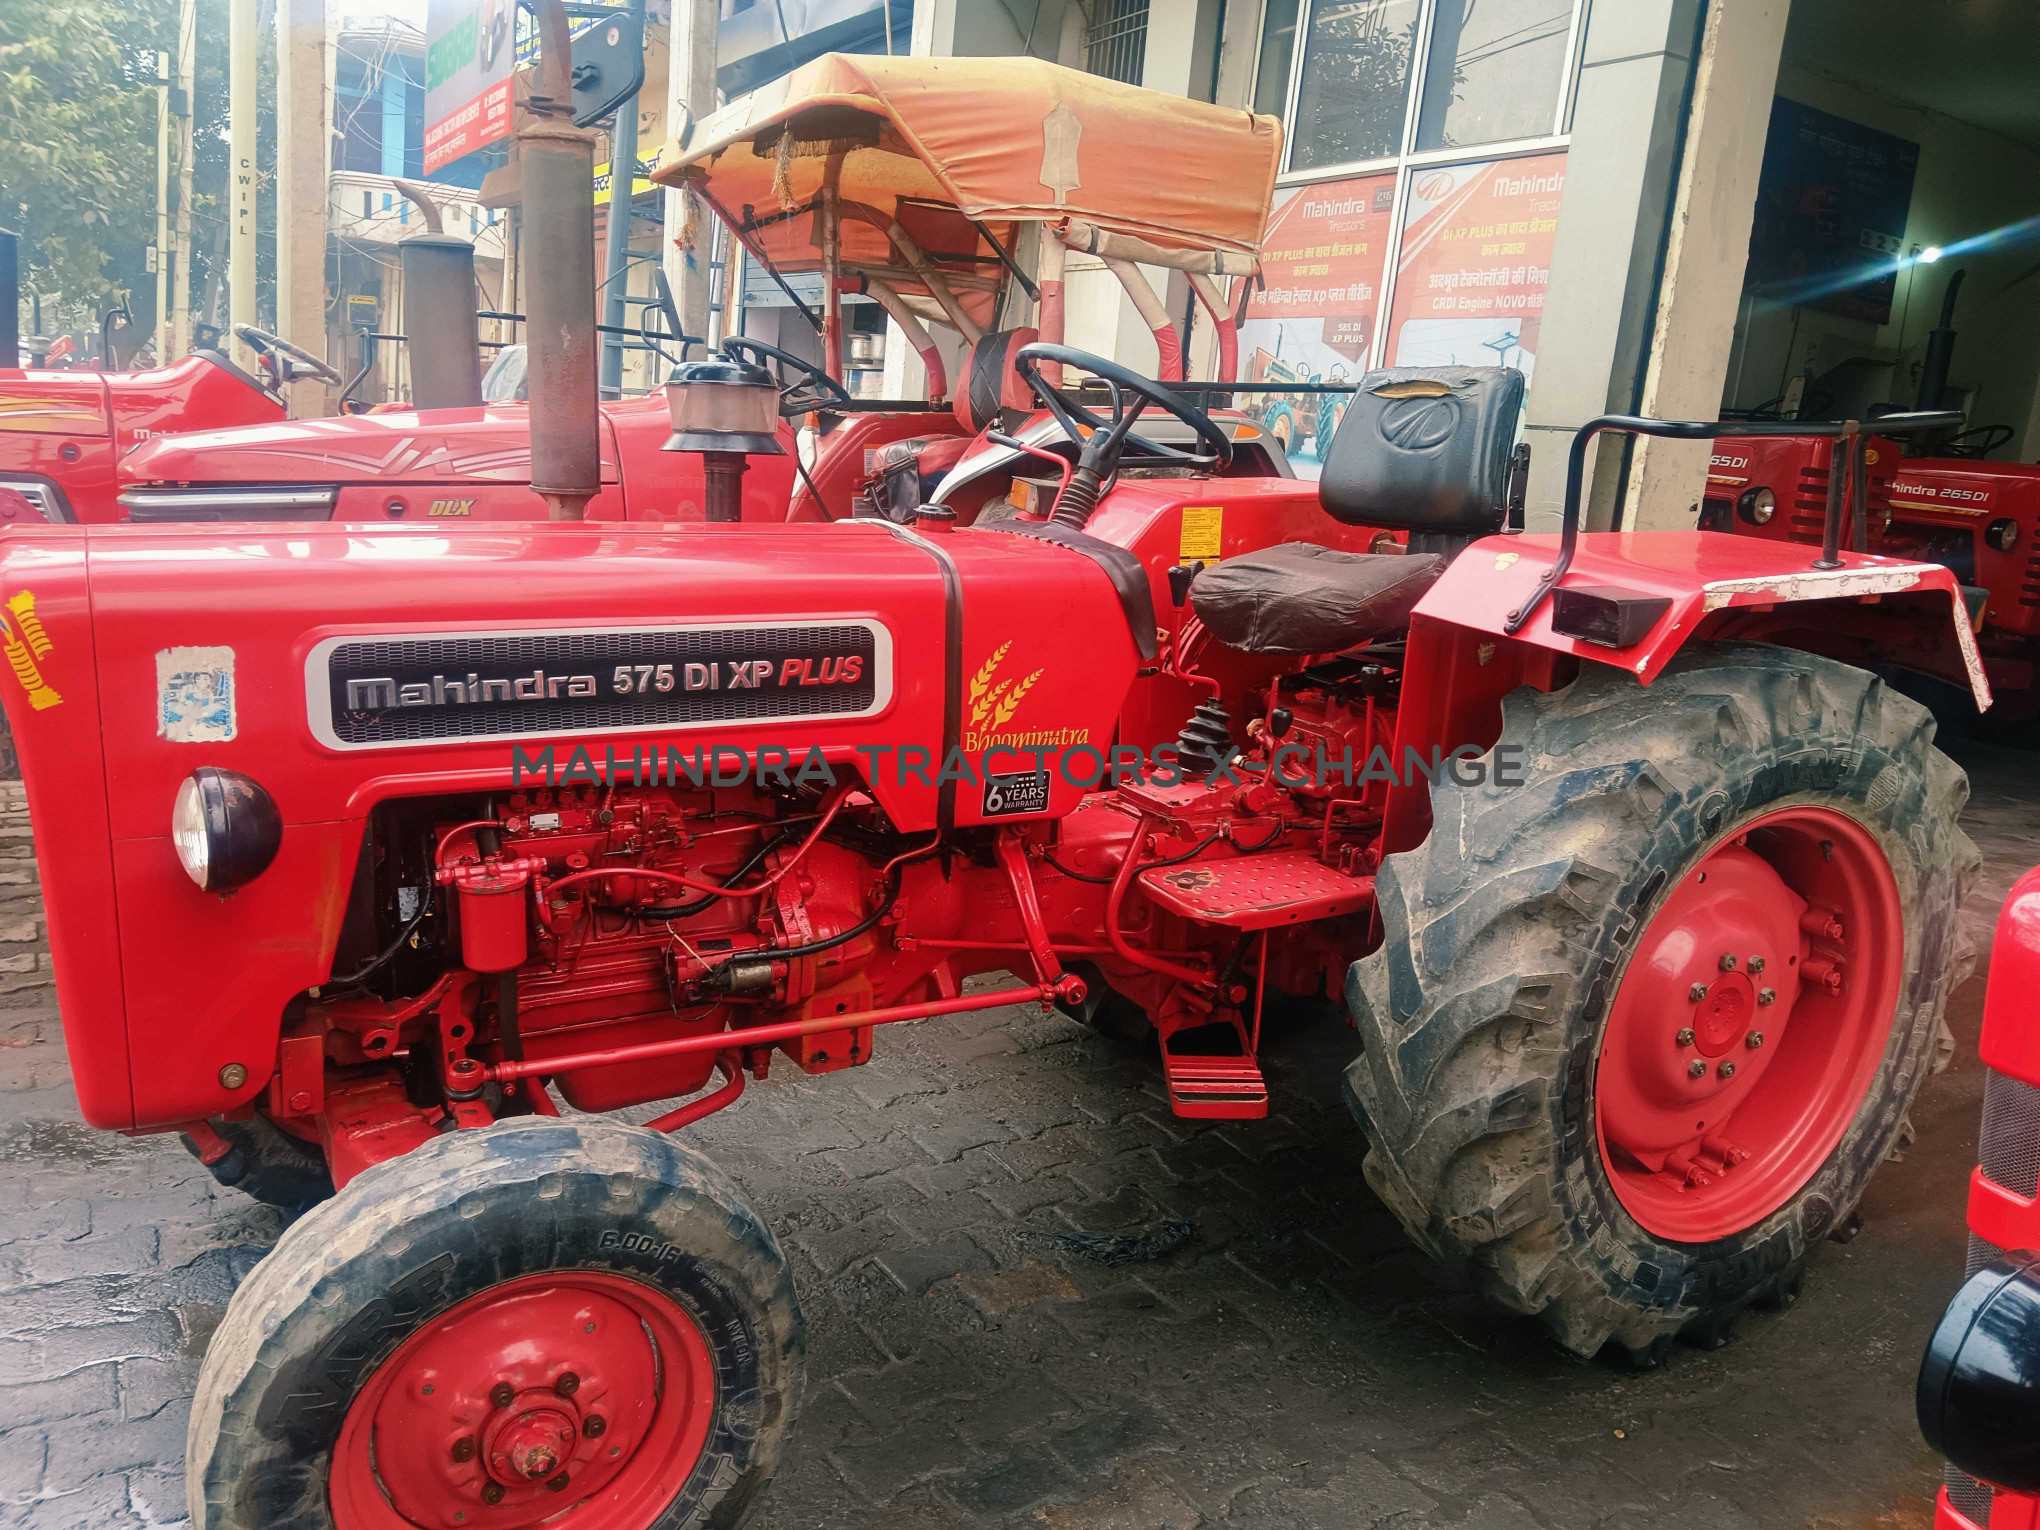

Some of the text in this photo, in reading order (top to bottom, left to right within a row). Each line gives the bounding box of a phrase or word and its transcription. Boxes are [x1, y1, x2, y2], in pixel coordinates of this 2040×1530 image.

[1302, 197, 1366, 219] Mahindra
[1329, 219, 1366, 233] Tractors
[1443, 229, 1454, 241] DI
[1455, 227, 1467, 240] XP
[1469, 225, 1494, 239] PLUS
[1262, 251, 1271, 262] DI
[1272, 250, 1282, 262] XP
[1283, 248, 1304, 261] PLUS
[1512, 266, 1525, 286] की
[1432, 297, 1457, 310] CRDI
[1458, 296, 1493, 312] Engine
[1495, 295, 1526, 309] NOVO
[1338, 322, 1362, 332] 585 DI
[1332, 334, 1364, 344] XP PLUS
[1939, 488, 1990, 502] 265DI
[427, 499, 478, 517] DLX
[345, 654, 863, 710] Mahindra 575 DI XP PLUS
[964, 726, 1089, 755] Bhoomiputra
[986, 785, 1003, 812] 6
[1003, 798, 1044, 809] WARRANTY
[599, 1230, 682, 1264] 6.00-16
[725, 1317, 751, 1364] NYLON
